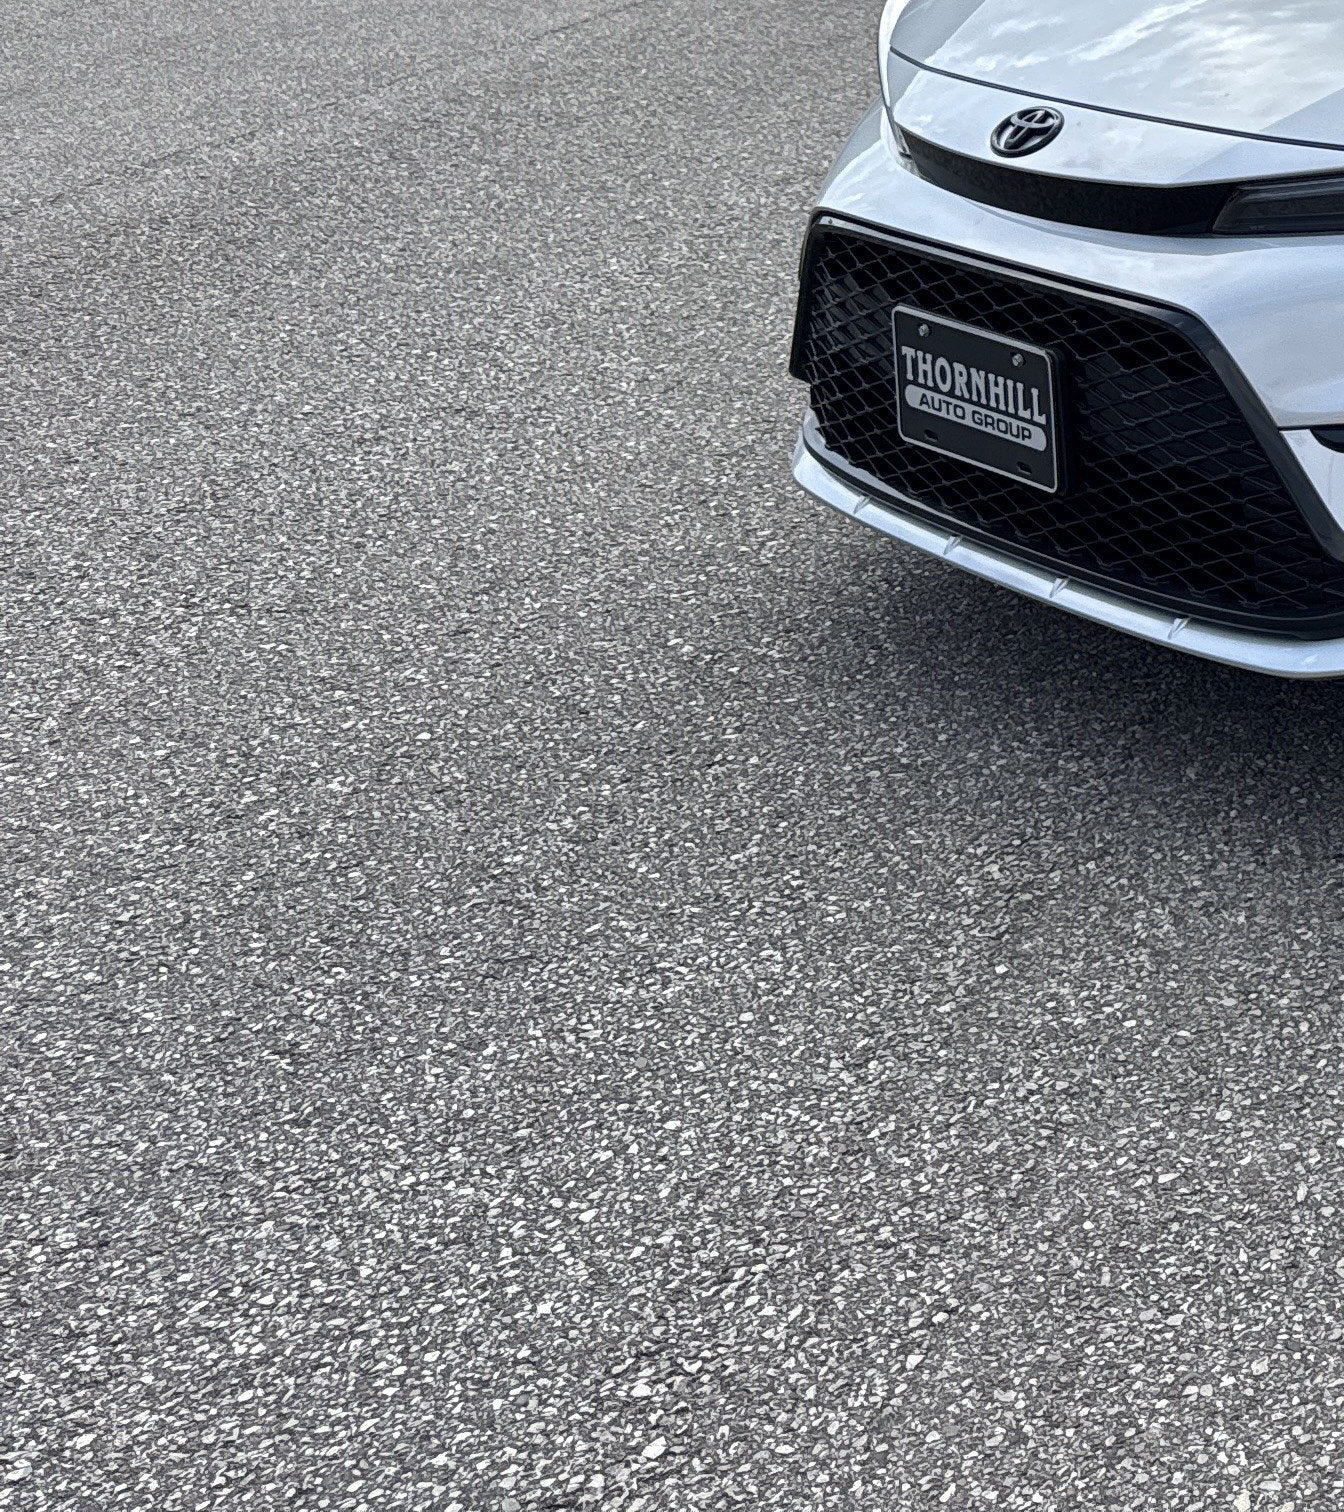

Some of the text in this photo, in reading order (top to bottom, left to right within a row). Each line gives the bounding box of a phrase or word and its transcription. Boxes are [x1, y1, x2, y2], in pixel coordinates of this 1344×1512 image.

[901, 345, 1047, 425] THORNHILL
[918, 393, 1032, 441] AUTO GROUP
